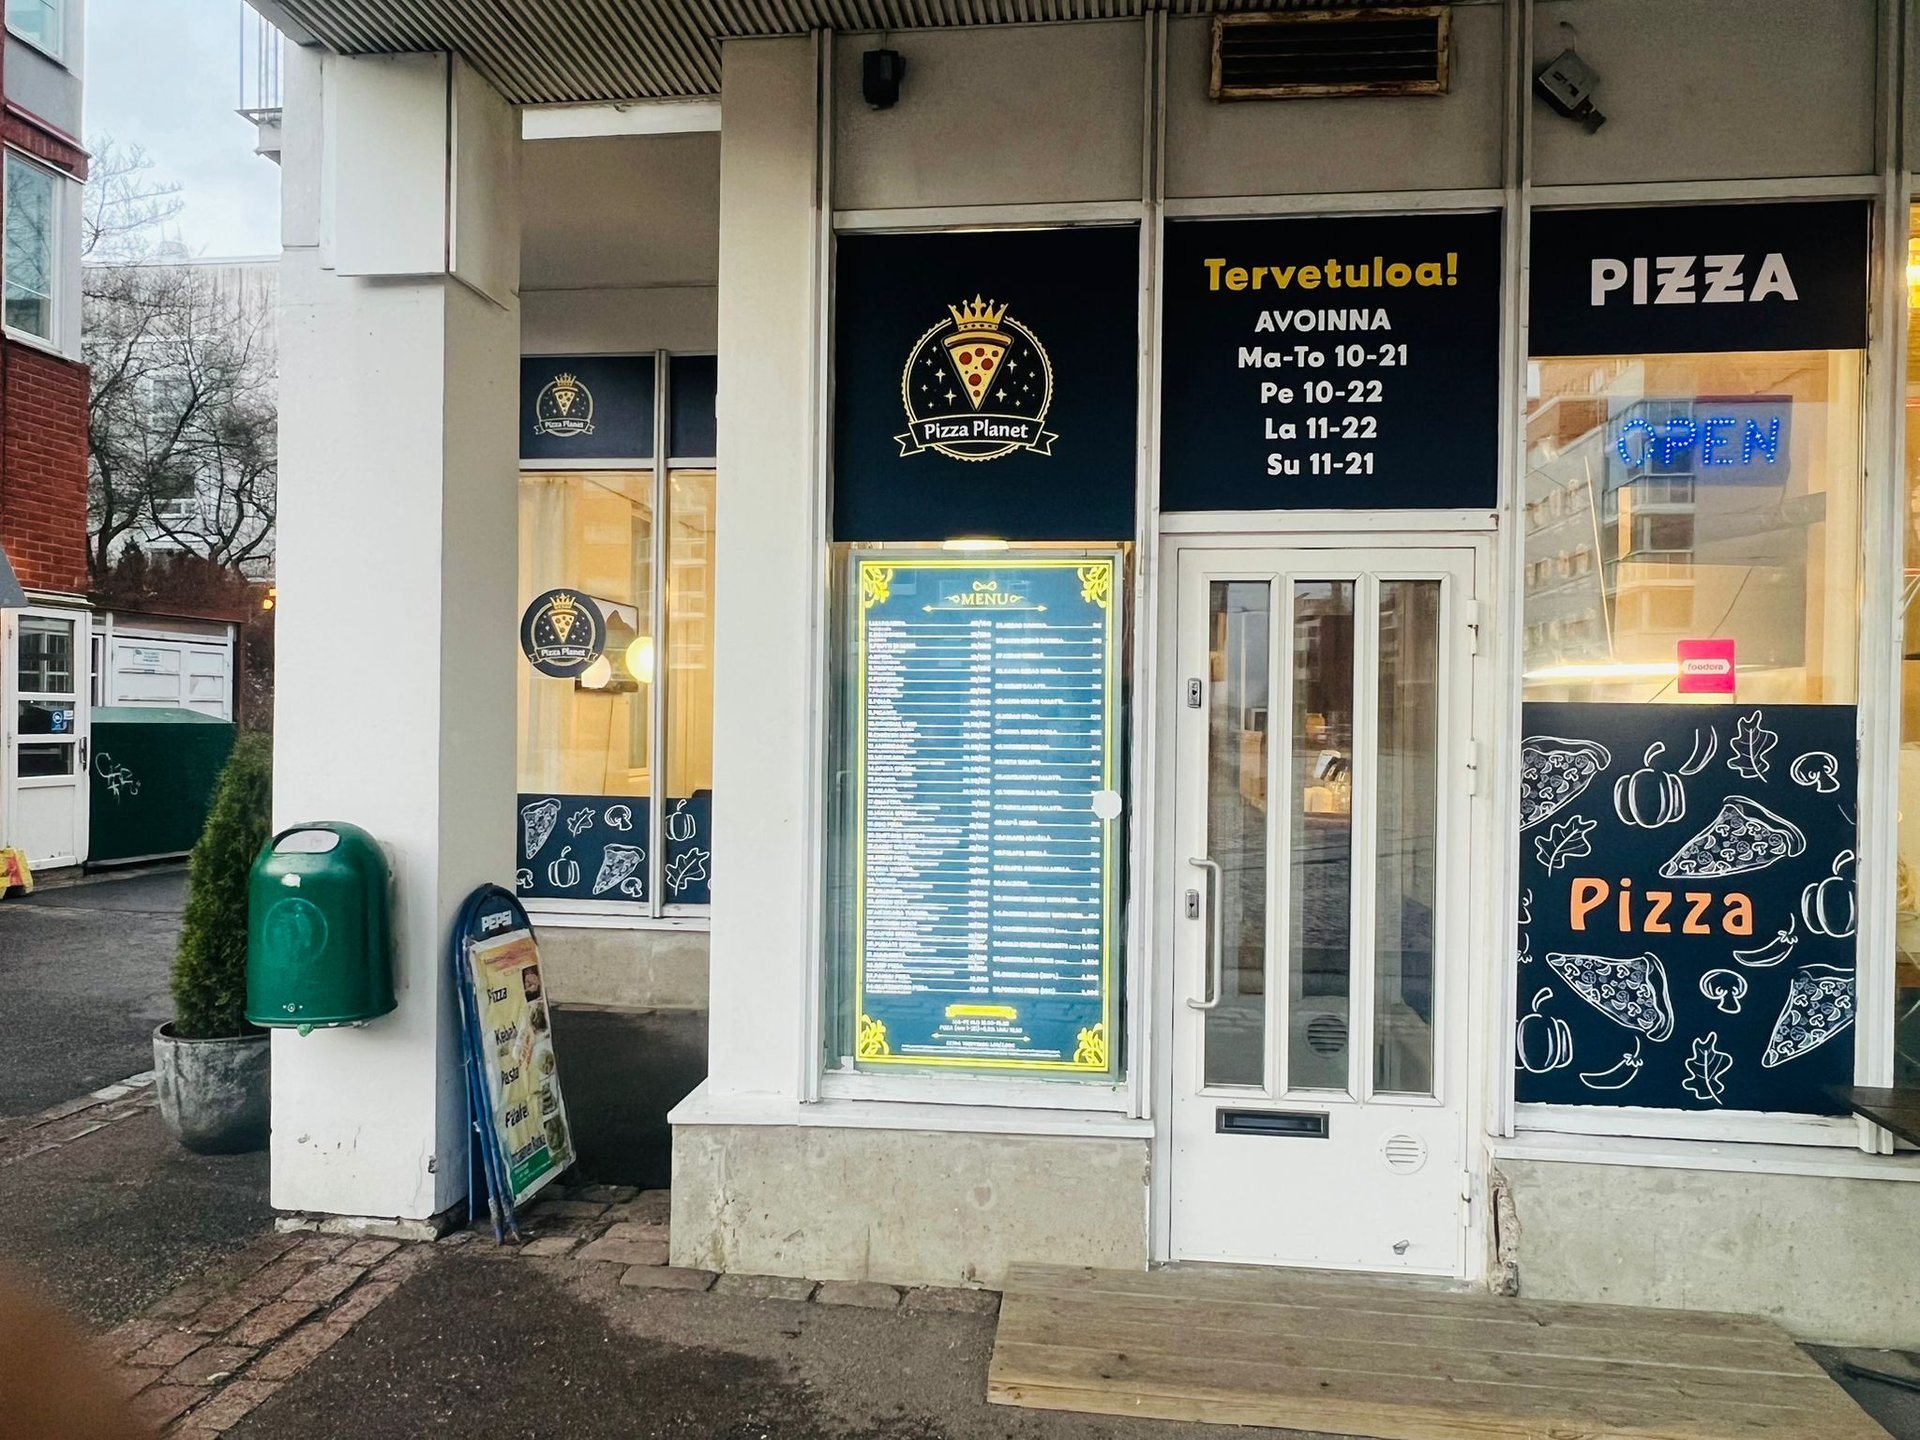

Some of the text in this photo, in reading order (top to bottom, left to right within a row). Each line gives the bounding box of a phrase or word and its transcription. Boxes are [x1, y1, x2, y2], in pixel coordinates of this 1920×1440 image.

[1203, 252, 1459, 291] Tervetuloa!
[1590, 252, 1799, 306] PIZZA
[1254, 308, 1392, 332] AVOINNA
[1237, 344, 1408, 369] Ma-To 10-21
[1260, 380, 1384, 404] Pe 10-22
[924, 419, 1029, 440] Pizza Planet
[1265, 416, 1377, 440] La 11-22
[1616, 416, 1780, 466] OPEN
[1267, 452, 1375, 475] Su 11-21
[961, 592, 1009, 606] MENU
[541, 647, 586, 657] Pizza Planet
[1687, 662, 1724, 671] foodora
[1569, 877, 1754, 936] Pizza
[481, 910, 513, 932] PEPSI
